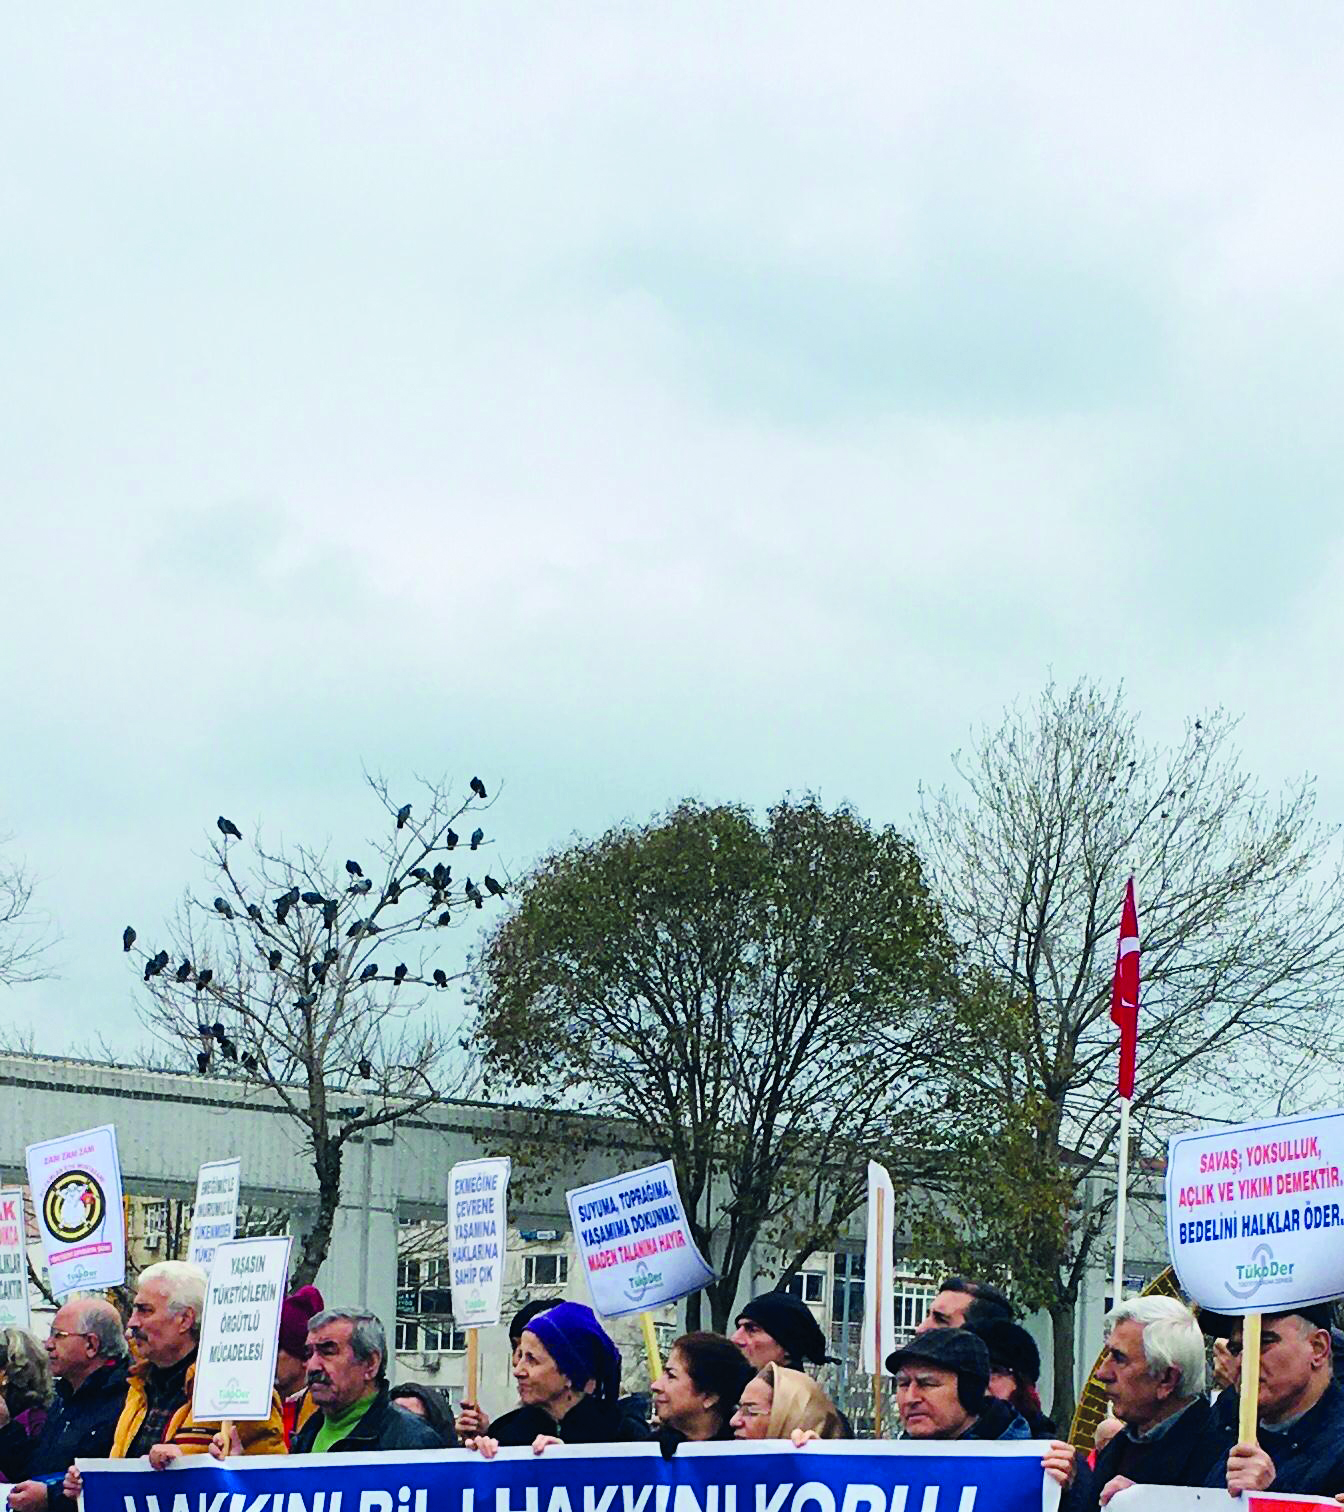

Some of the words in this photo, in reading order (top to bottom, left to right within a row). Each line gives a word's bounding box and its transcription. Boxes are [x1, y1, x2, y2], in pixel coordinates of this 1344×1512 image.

[1199, 1147, 1243, 1175] SAVAŞ;
[1246, 1136, 1322, 1167] YOKSULLUK,
[454, 1173, 499, 1197] EKMEĞİNE
[1178, 1183, 1215, 1213] AÇLIK
[1218, 1182, 1234, 1202] VE
[1238, 1176, 1273, 1200] YIKIM
[1276, 1162, 1344, 1195] DEMEKTİR.
[455, 1197, 495, 1223] ÇEVRENE
[577, 1199, 619, 1223] SUYUMA,
[618, 1179, 673, 1213] TOPRAĞIMA,
[454, 1219, 496, 1245] YAŞAMINA
[1179, 1210, 1238, 1245] BEDELİNİ
[1241, 1209, 1300, 1238] HALKLAR
[1304, 1200, 1344, 1230] ÖDER.
[587, 1253, 618, 1273] MADEN
[658, 1229, 686, 1255] HAYIR
[230, 1254, 266, 1279] YAŞASIN
[454, 1264, 478, 1286] SAHİP
[478, 1264, 493, 1288] ÇIK
[212, 1282, 277, 1306] TÜKETİCİLERİN
[220, 1308, 260, 1334] ÖRGÜTLÜ
[208, 1340, 264, 1364] MÜCADELESİ
